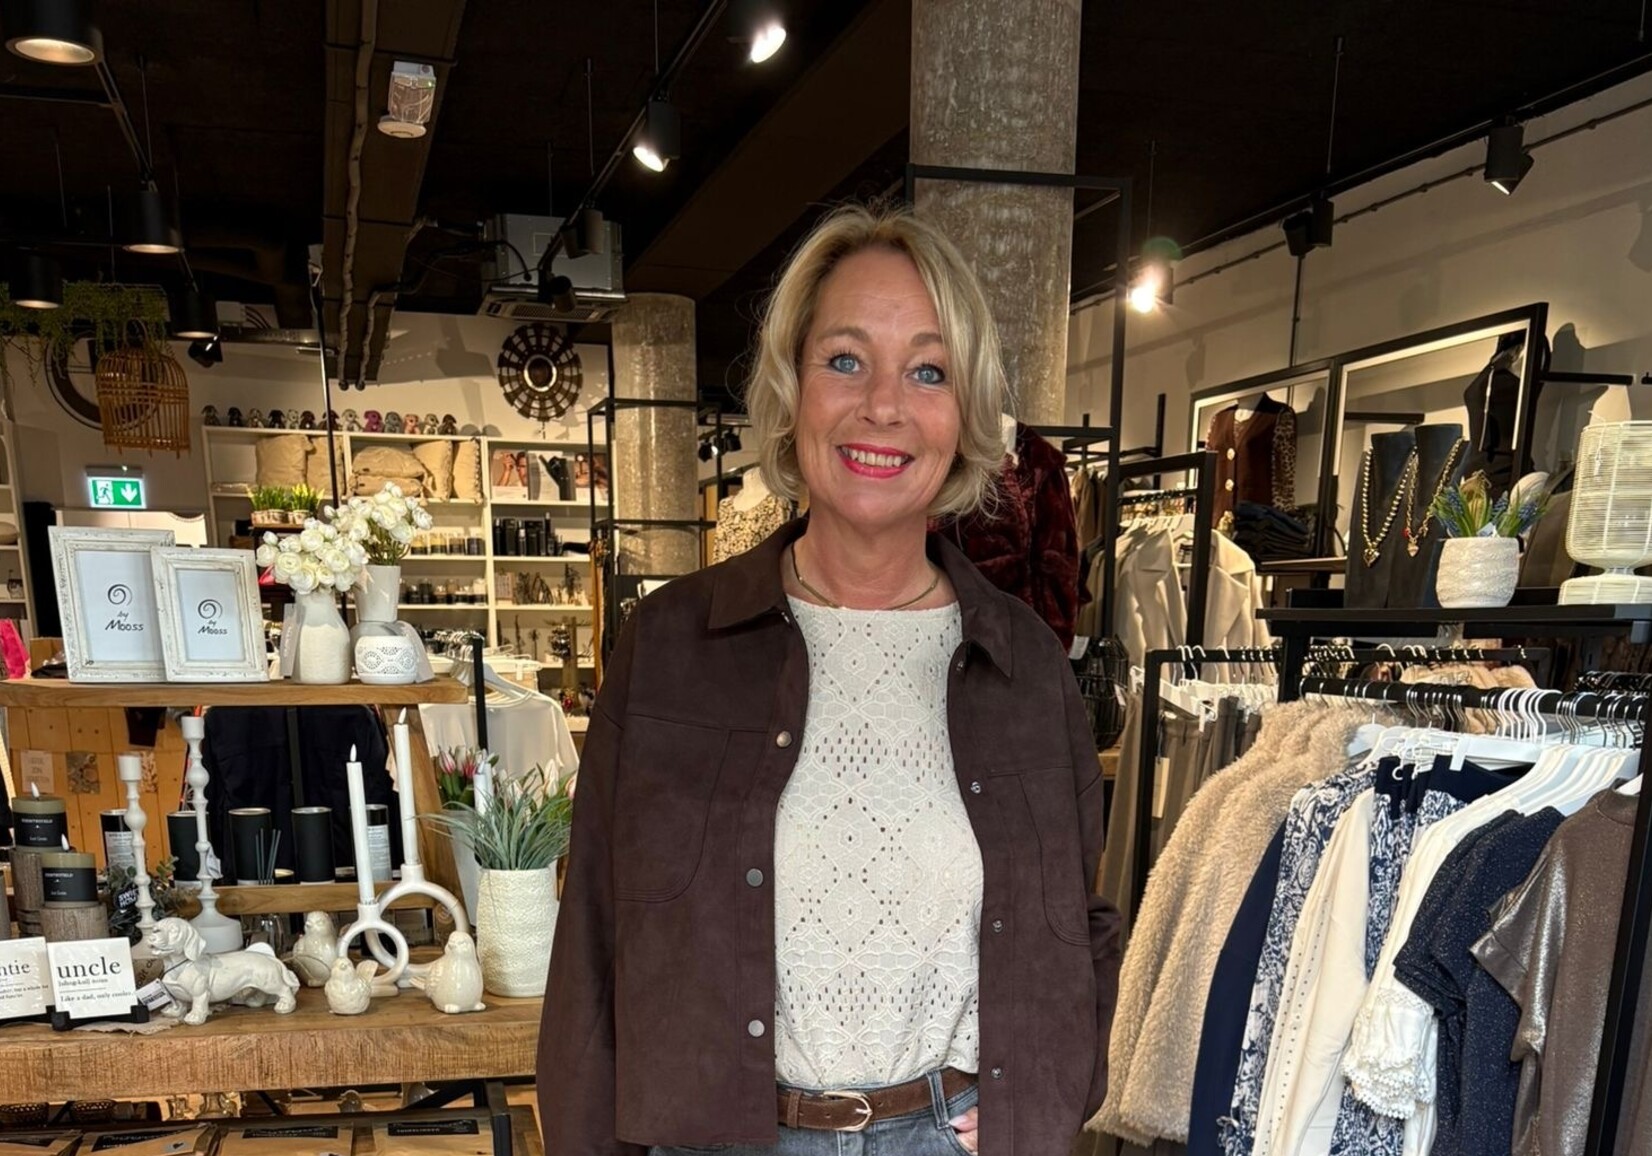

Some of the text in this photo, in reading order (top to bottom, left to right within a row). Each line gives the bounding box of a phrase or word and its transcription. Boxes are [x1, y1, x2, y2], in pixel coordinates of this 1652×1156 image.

[117, 610, 129, 621] by
[105, 619, 144, 631] Mooss
[197, 626, 228, 635] Mooss
[56, 956, 122, 979] uncle
